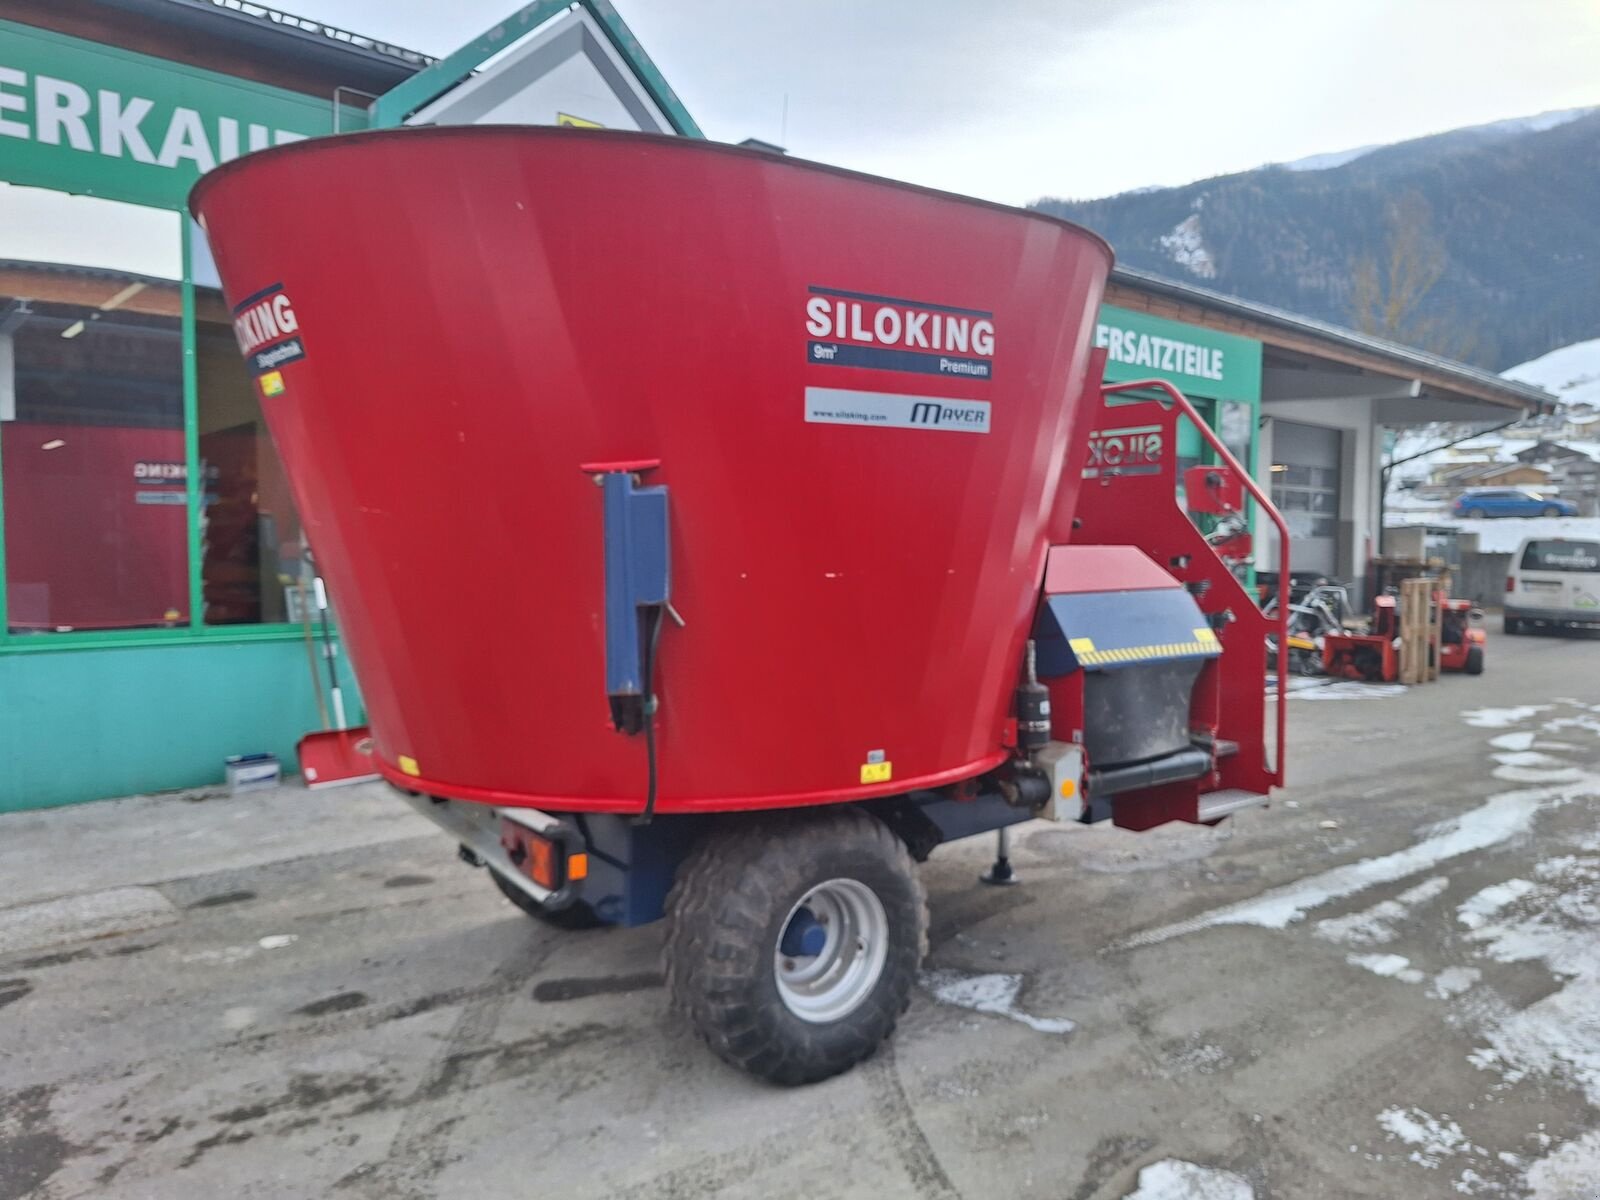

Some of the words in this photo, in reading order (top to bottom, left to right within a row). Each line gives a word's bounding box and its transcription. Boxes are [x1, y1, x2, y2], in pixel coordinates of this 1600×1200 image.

[0, 66, 311, 174] ERKAU
[806, 297, 995, 356] SILOKING
[1096, 324, 1223, 380] ERSATZTEILE
[940, 358, 988, 376] Premium
[910, 402, 985, 424] MAYER
